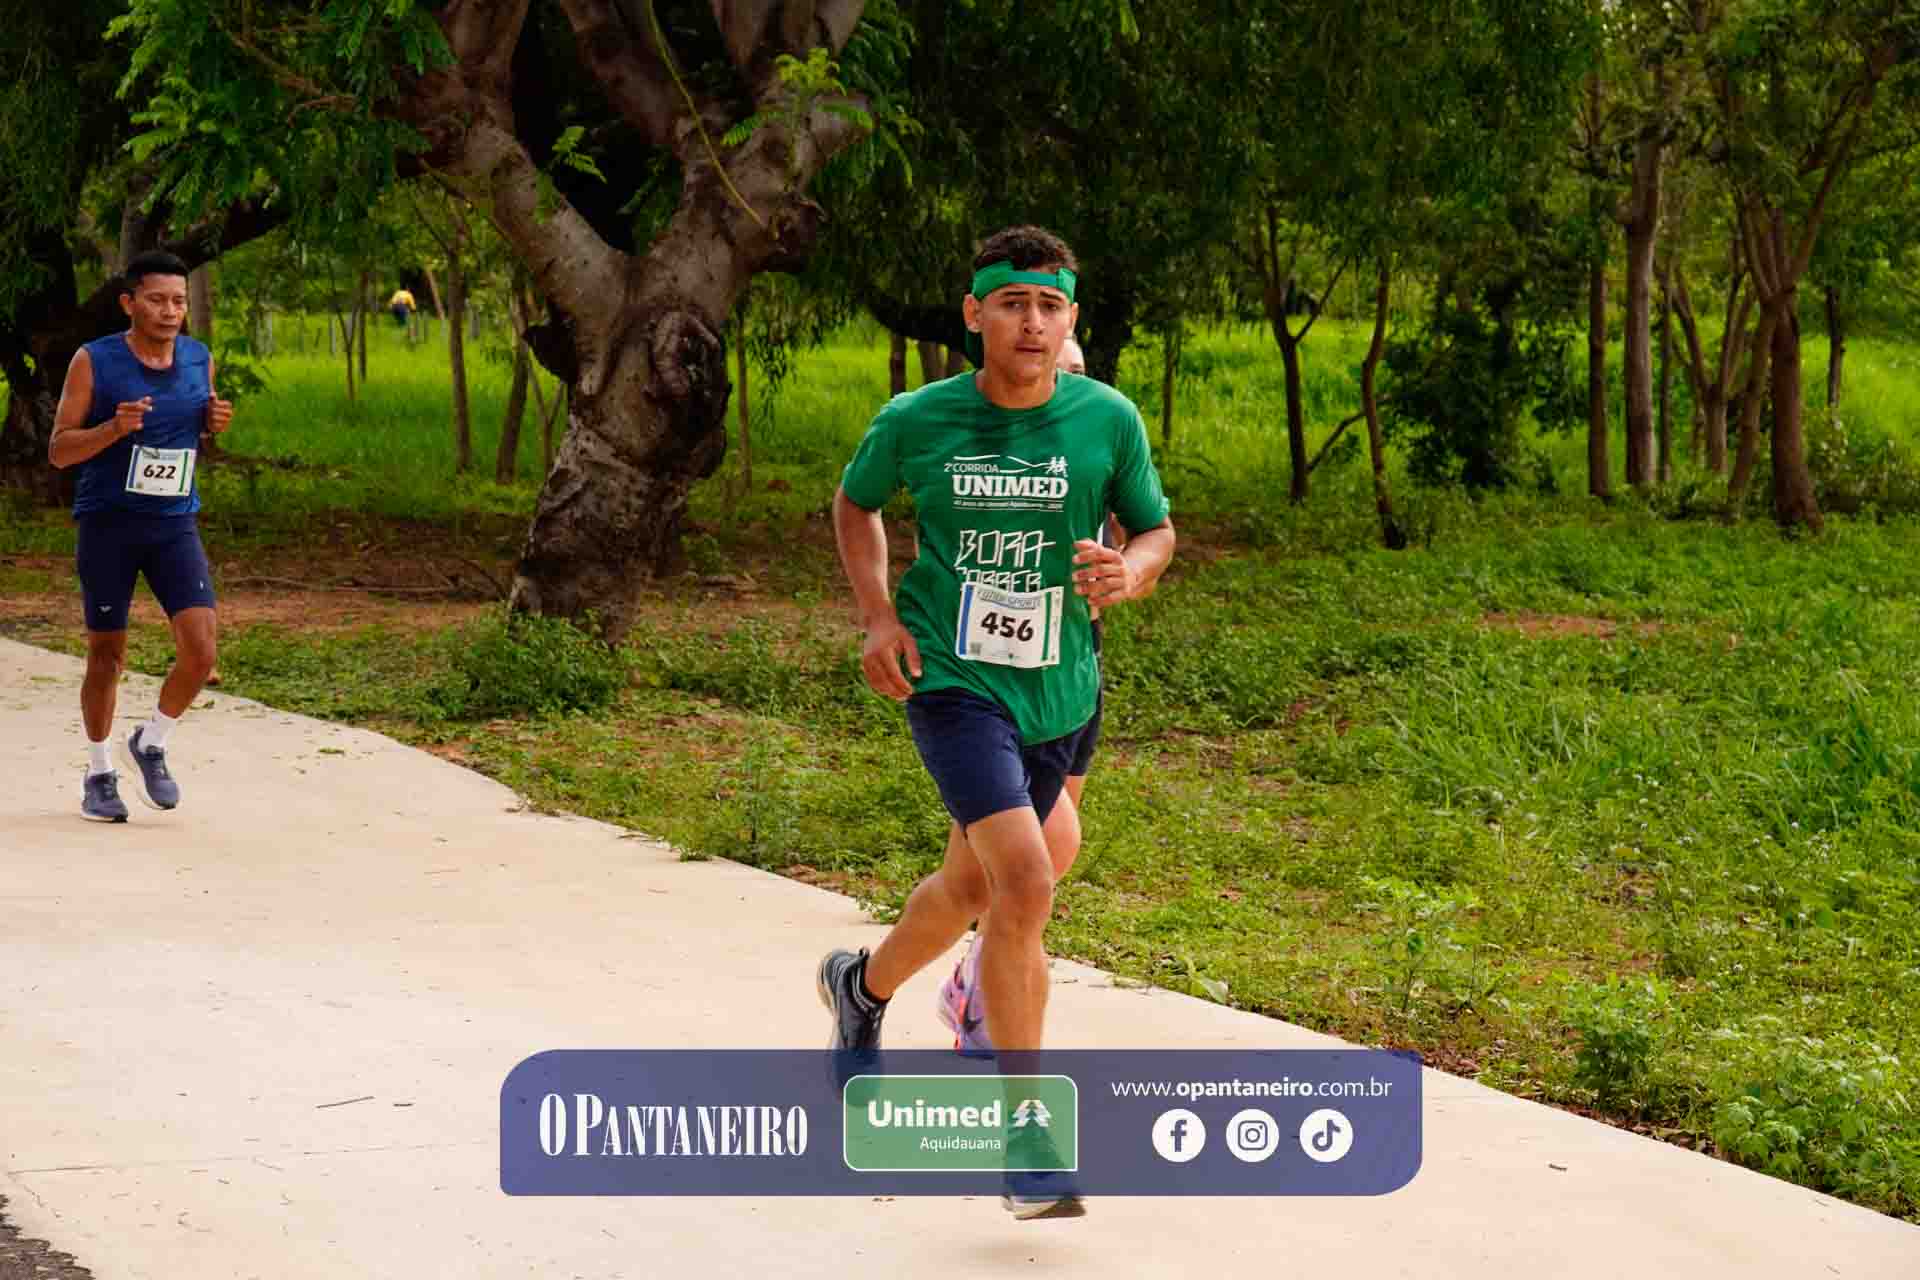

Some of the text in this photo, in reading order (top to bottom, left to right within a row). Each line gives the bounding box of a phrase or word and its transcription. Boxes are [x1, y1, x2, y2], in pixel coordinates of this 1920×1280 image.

[144, 464, 176, 479] 622
[953, 463, 1000, 473] CORRIDA
[952, 475, 1069, 498] UNIMED
[953, 530, 1056, 567] BORA
[981, 611, 1034, 642] 456
